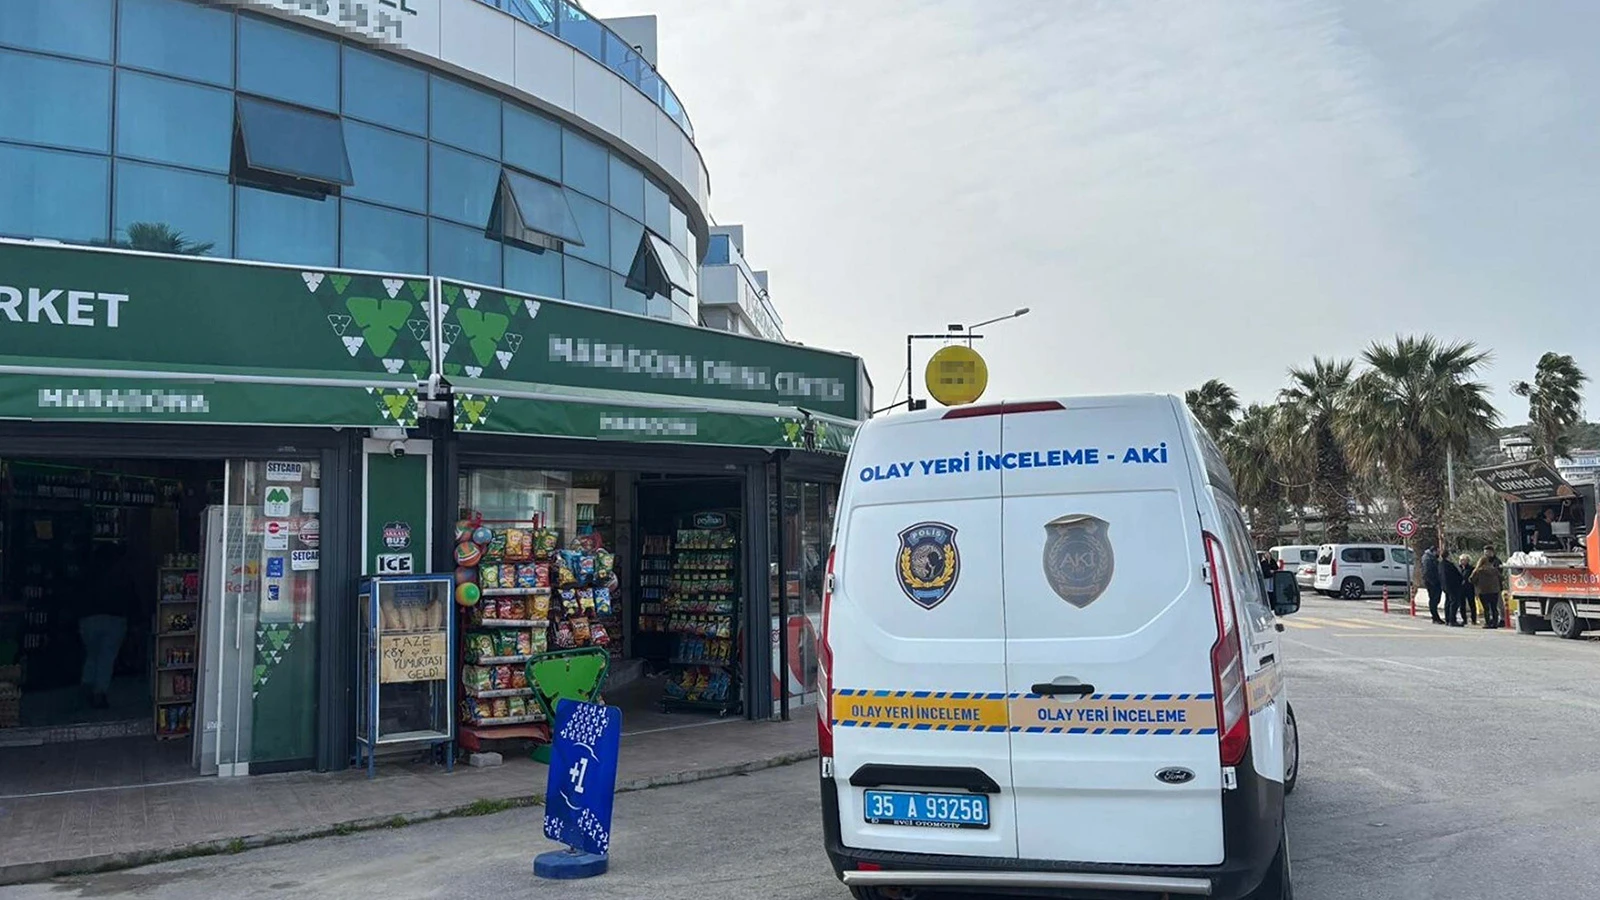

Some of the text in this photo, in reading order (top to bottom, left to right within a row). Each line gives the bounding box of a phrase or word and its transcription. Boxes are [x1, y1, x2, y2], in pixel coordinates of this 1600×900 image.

[0, 285, 129, 327] RKET
[860, 461, 914, 482] OLAY
[919, 451, 970, 475] YERİ
[977, 449, 1099, 471] İNCELEME
[1123, 442, 1168, 463] AKİ
[911, 529, 942, 539] POLİS
[1400, 523, 1413, 532] 50
[379, 556, 411, 572] ICE
[1590, 574, 1600, 584] 01
[392, 636, 431, 647] TAZE
[384, 647, 405, 658] KÖY
[394, 656, 442, 669] YUMURTASI
[408, 667, 439, 679] GELDİ
[851, 705, 980, 721] OLAY YERİ İNCELEME
[1038, 706, 1186, 722] OLAY YERİ İNCELEME
[569, 757, 589, 794] +1
[872, 795, 983, 821] 35 A 93258
